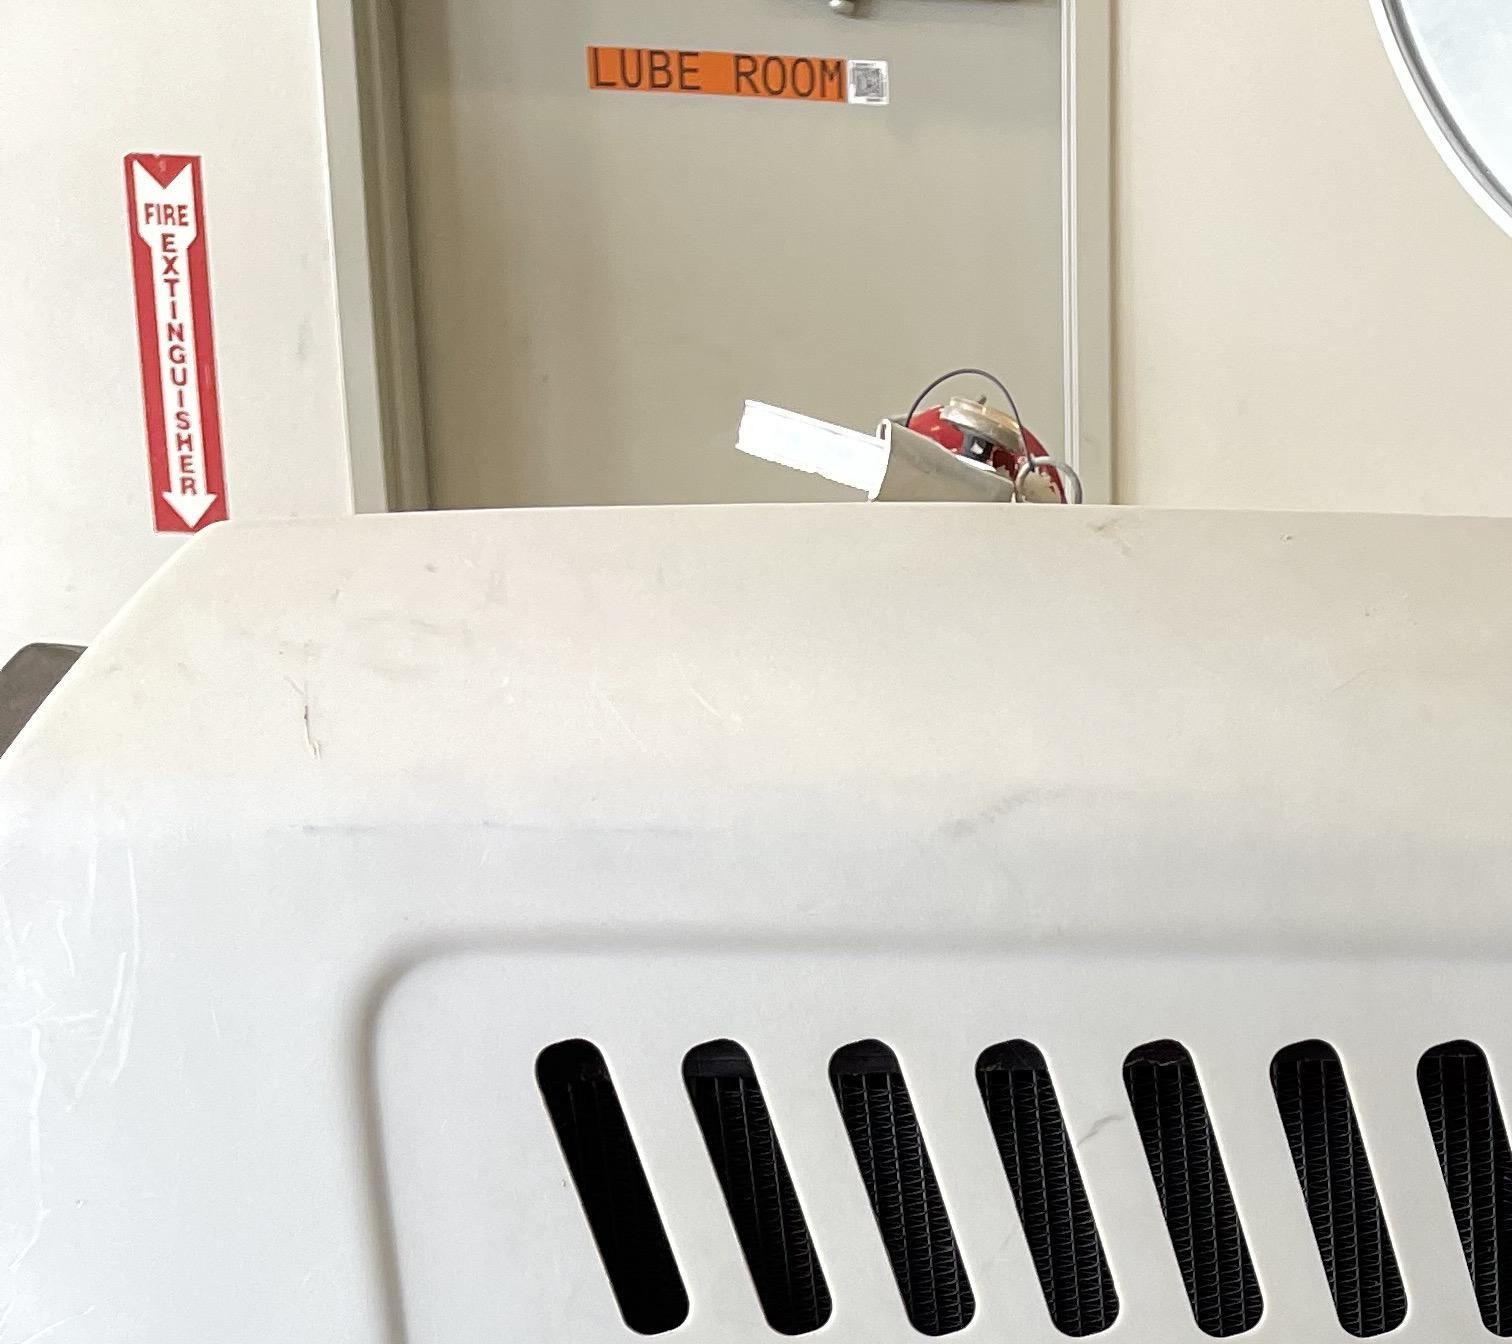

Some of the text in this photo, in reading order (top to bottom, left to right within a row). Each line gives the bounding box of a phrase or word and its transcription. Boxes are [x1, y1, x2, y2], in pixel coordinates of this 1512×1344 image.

[593, 47, 843, 98] LUBE ROOM
[144, 203, 189, 226] FIRE
[161, 233, 197, 496] EXTINGUISHER
